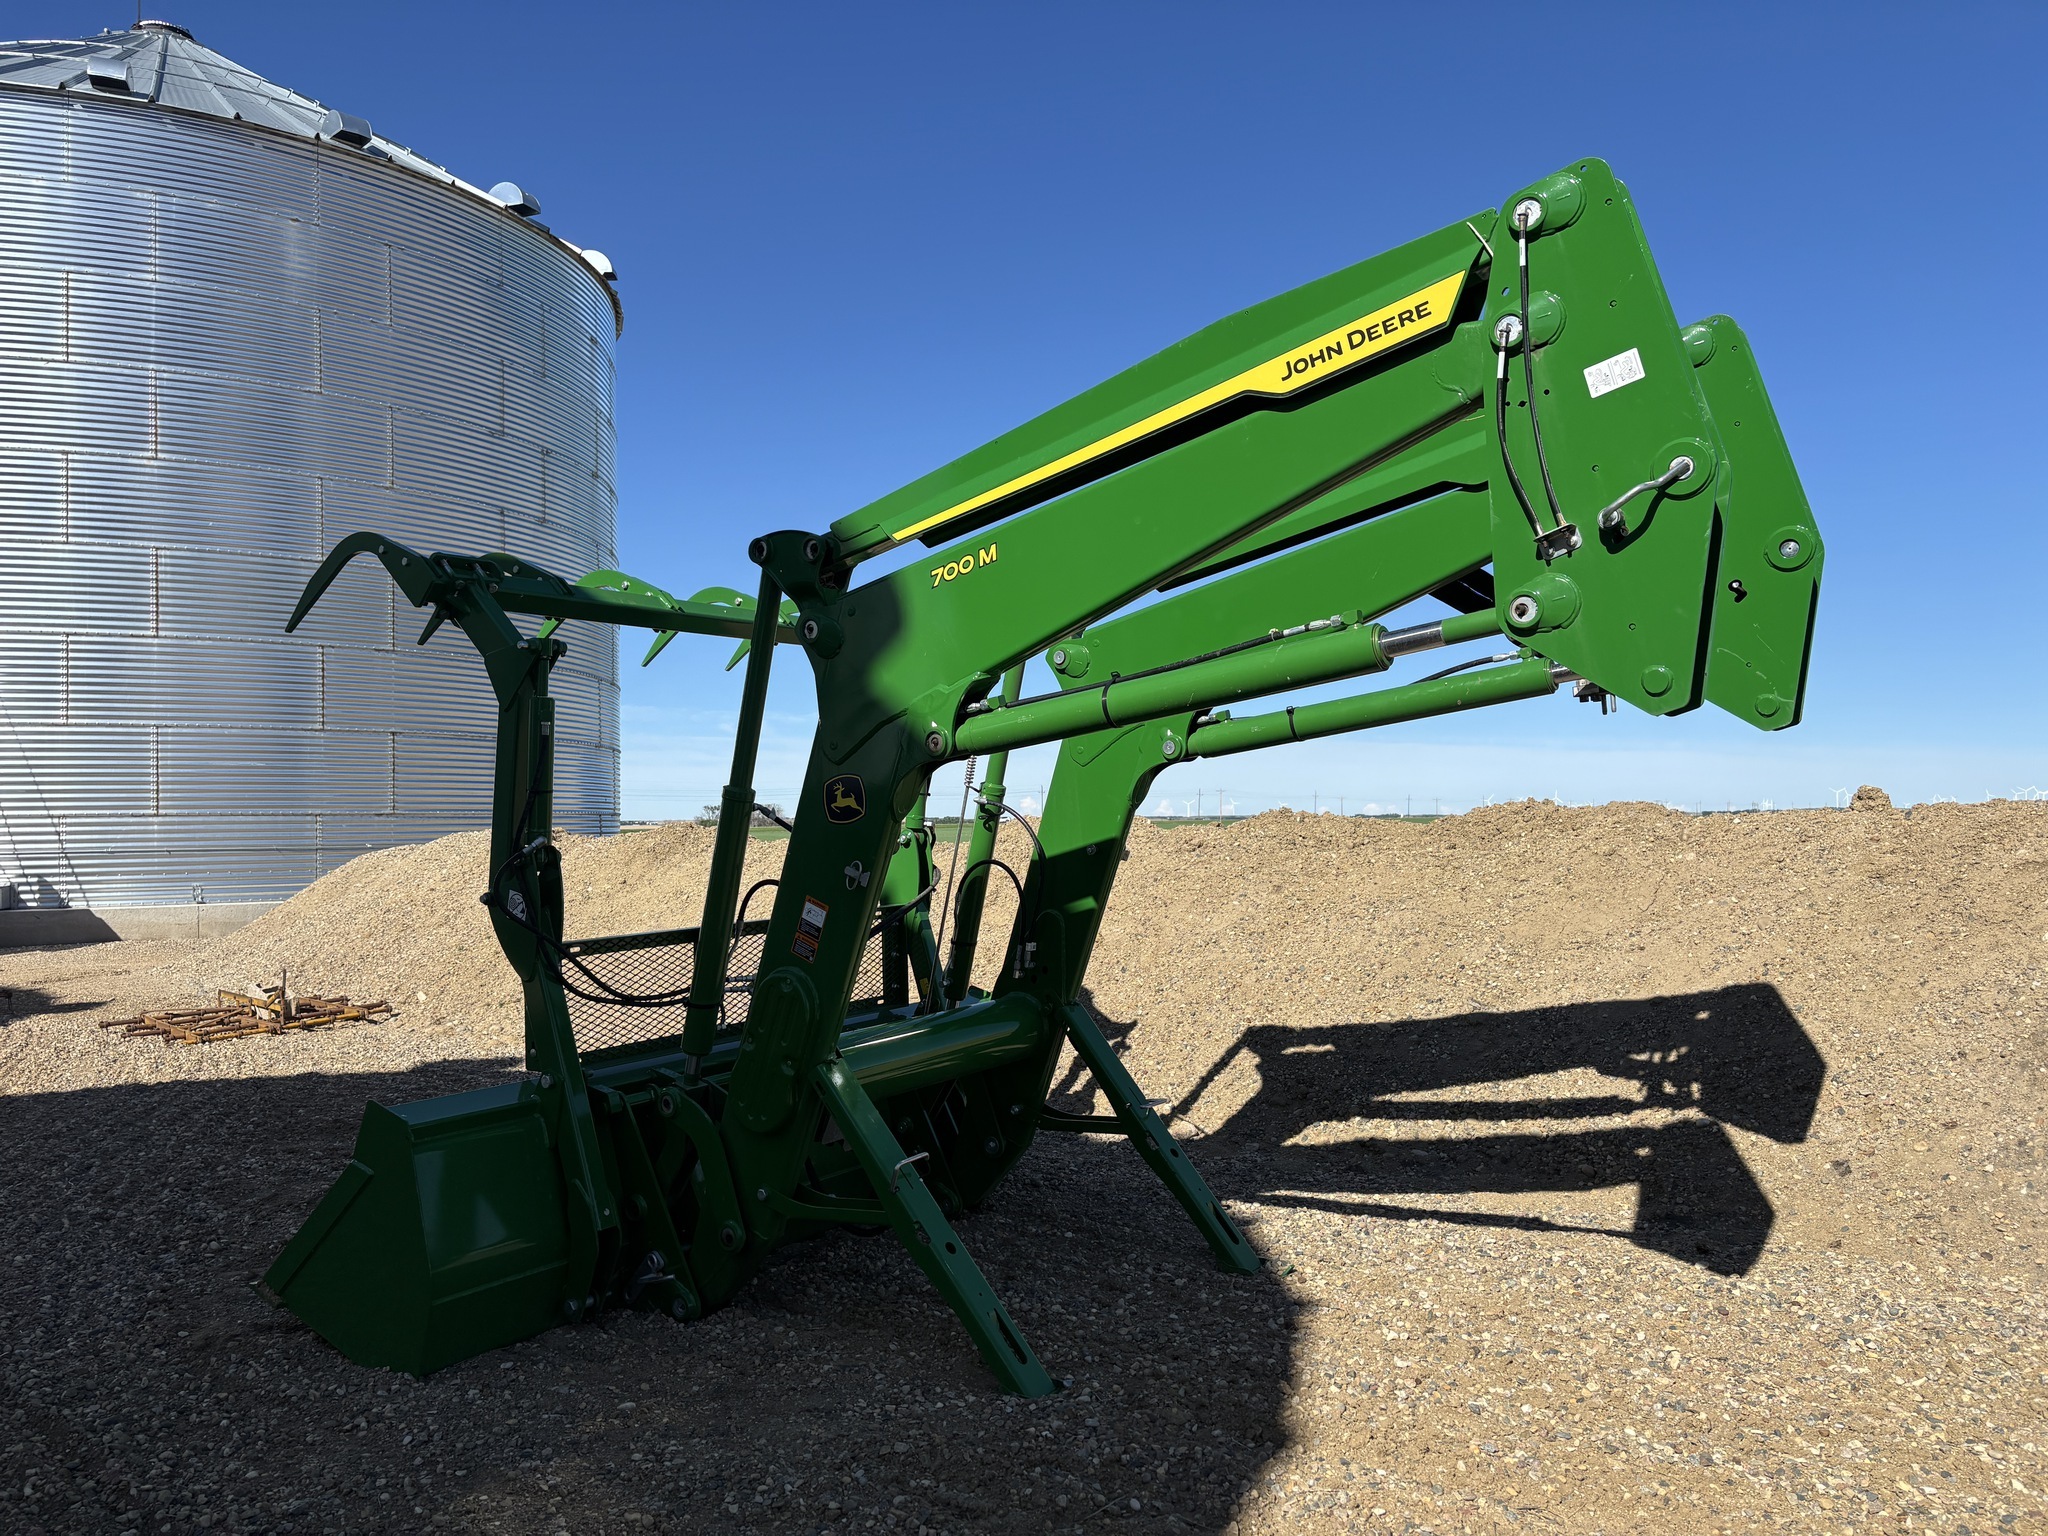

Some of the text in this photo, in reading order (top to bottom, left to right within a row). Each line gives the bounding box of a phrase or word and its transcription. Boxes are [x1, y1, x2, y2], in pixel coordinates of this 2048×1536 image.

[1281, 300, 1432, 381] JOHN DEERE
[930, 542, 998, 589] 700 M
